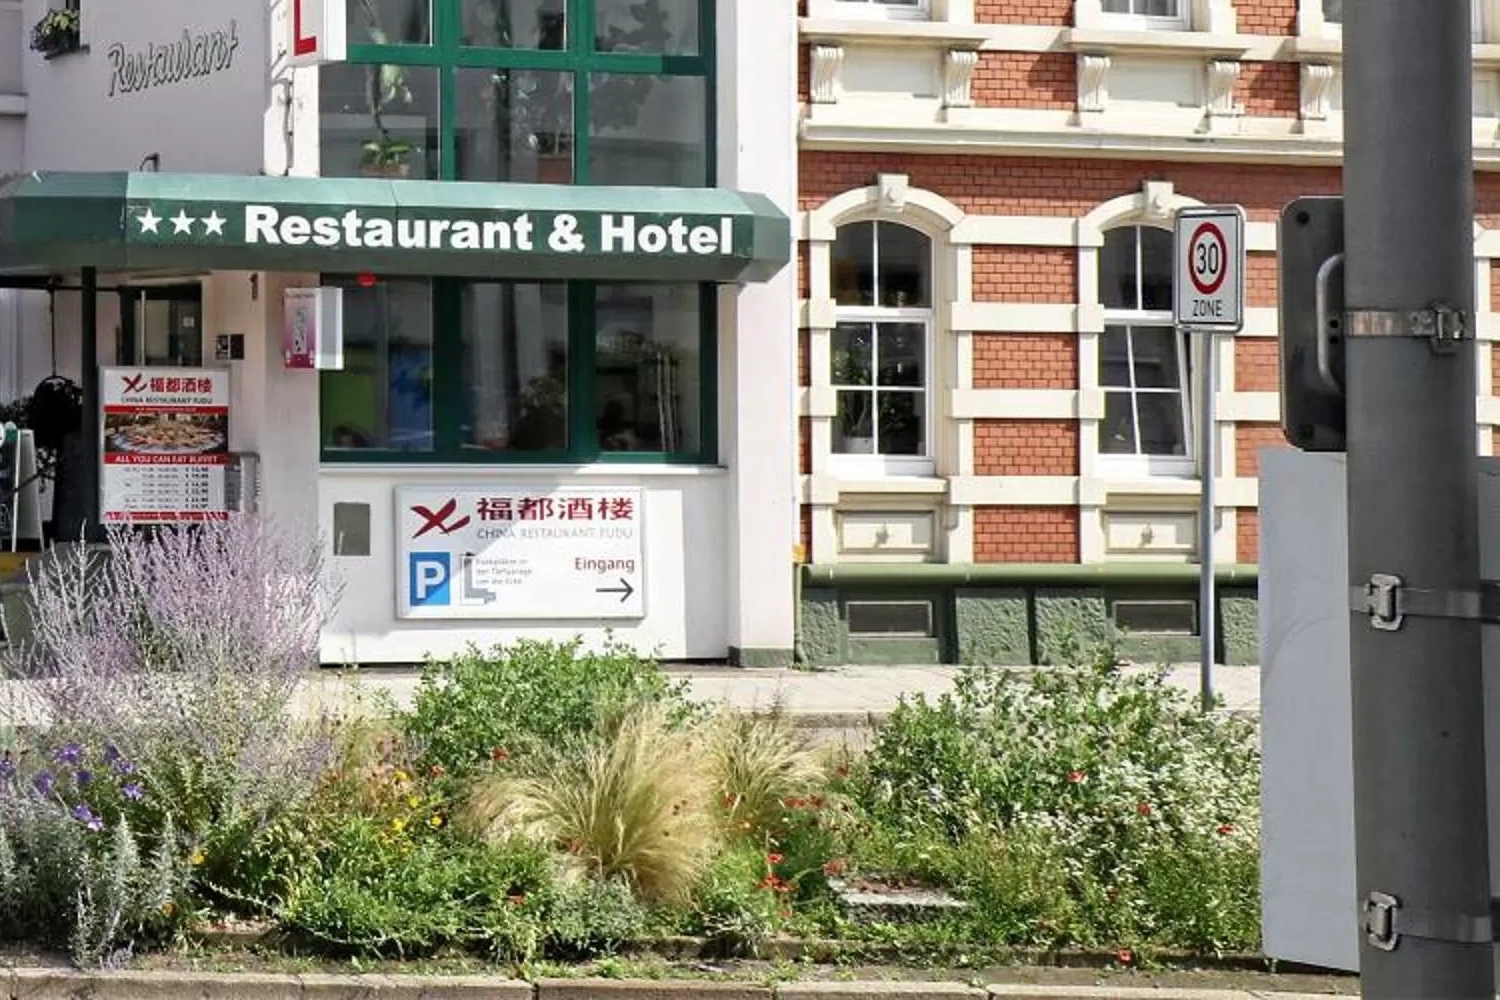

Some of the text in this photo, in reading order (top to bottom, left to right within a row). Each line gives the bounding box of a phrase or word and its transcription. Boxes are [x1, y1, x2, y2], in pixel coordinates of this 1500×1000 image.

[108, 18, 239, 97] Restaurant
[244, 205, 733, 256] Restaurant & Hotel
[1195, 242, 1219, 275] 30
[1192, 299, 1222, 317] ZONE
[476, 497, 634, 521] 福都酒楼
[477, 528, 515, 539] CHINA
[574, 557, 635, 574] Eingang
[416, 561, 445, 599] P
